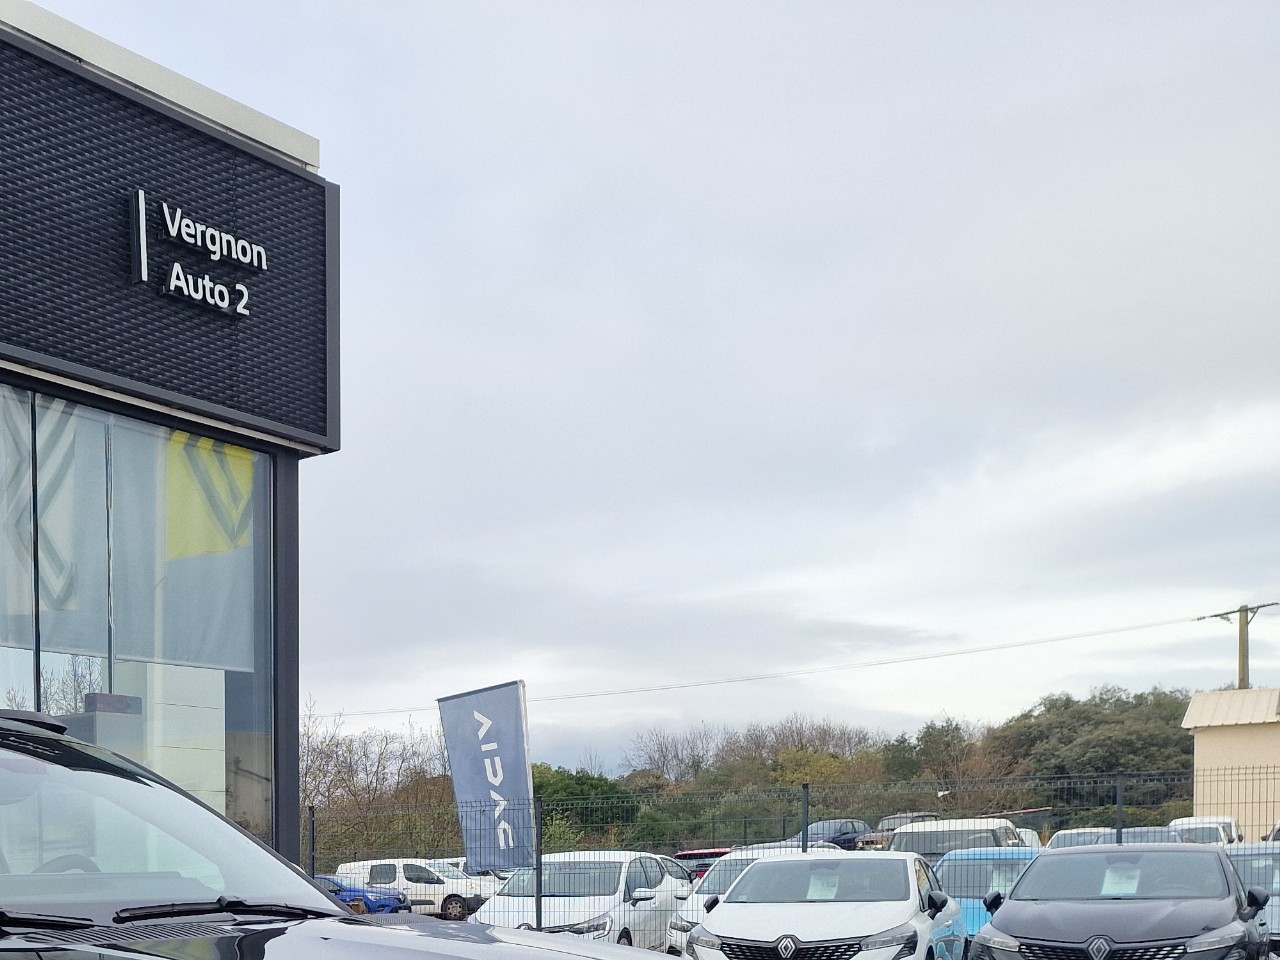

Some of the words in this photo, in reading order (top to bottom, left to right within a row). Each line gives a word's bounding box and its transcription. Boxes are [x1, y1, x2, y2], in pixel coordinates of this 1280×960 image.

[163, 202, 267, 270] Vergnon
[170, 262, 229, 308] Auto
[235, 283, 250, 315] 2
